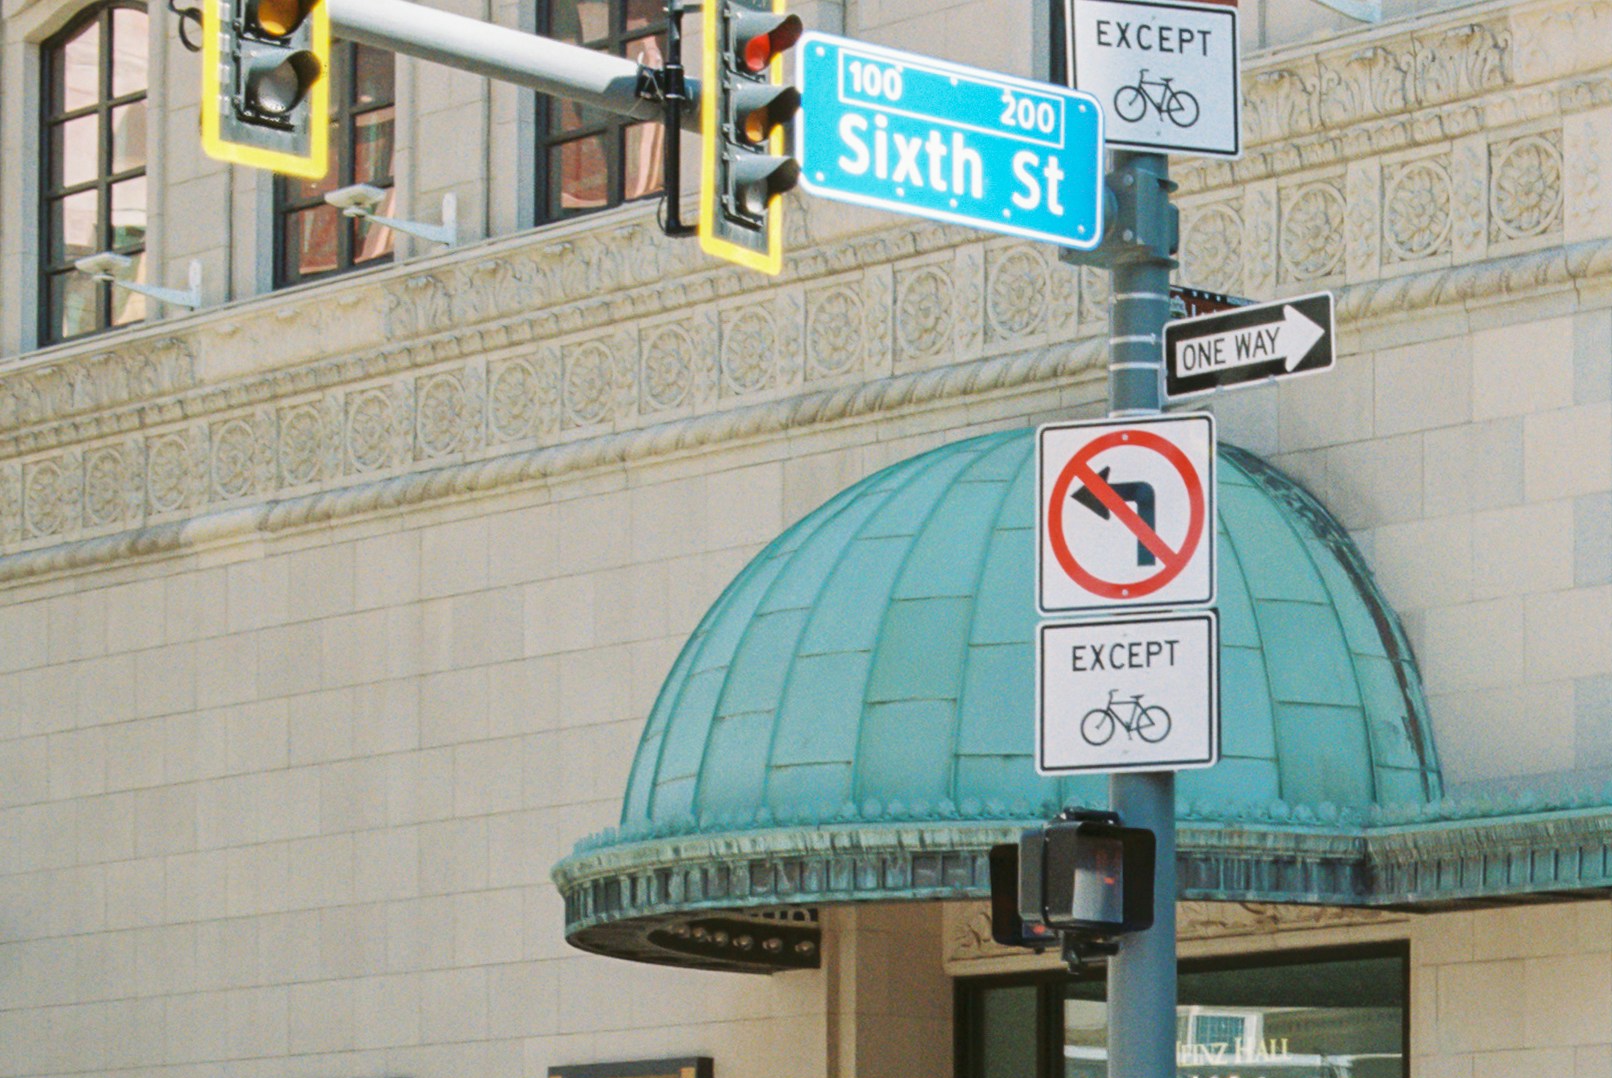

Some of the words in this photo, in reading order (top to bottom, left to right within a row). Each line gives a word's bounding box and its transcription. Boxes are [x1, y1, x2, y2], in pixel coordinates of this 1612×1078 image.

[1096, 19, 1212, 57] EXCEPT
[850, 61, 902, 101] 100
[1001, 93, 1055, 134] 200
[837, 112, 984, 199] Sixth
[1011, 152, 1065, 217] St
[1183, 342, 1227, 371] ONE
[1235, 328, 1281, 361] WAY
[1071, 640, 1180, 672] EXCEPT
[1235, 1037, 1293, 1063] HALL
